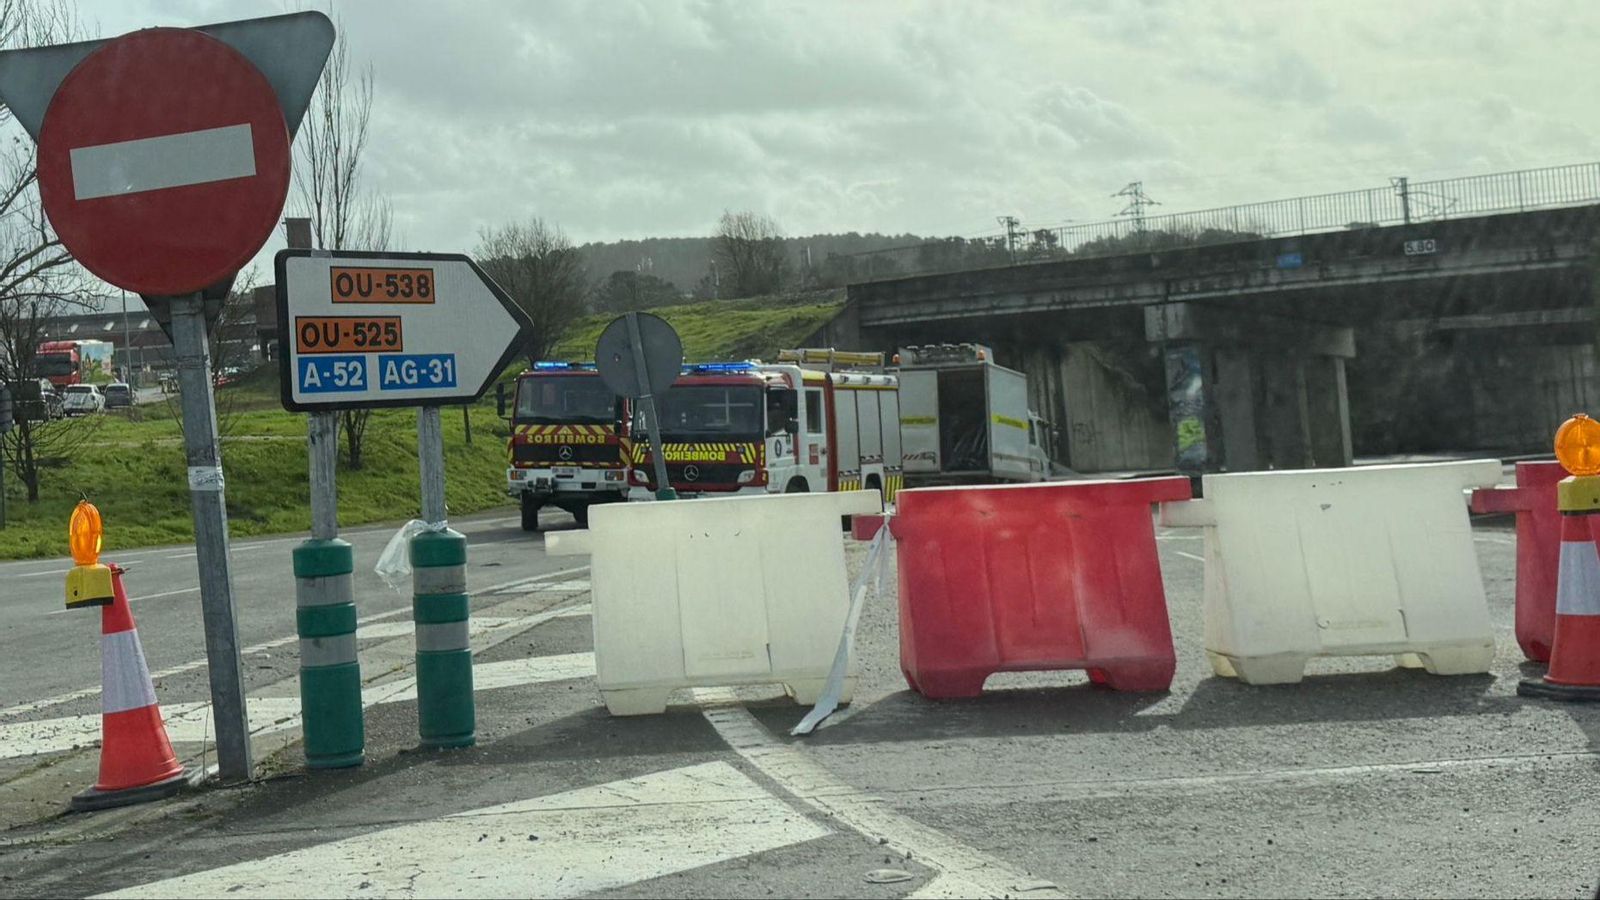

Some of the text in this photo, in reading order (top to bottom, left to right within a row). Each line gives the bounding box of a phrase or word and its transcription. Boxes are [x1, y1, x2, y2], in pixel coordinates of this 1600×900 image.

[335, 272, 431, 299] OU-538
[300, 321, 398, 348] OU-525
[303, 361, 364, 388] A-52
[384, 358, 454, 385] AG-31
